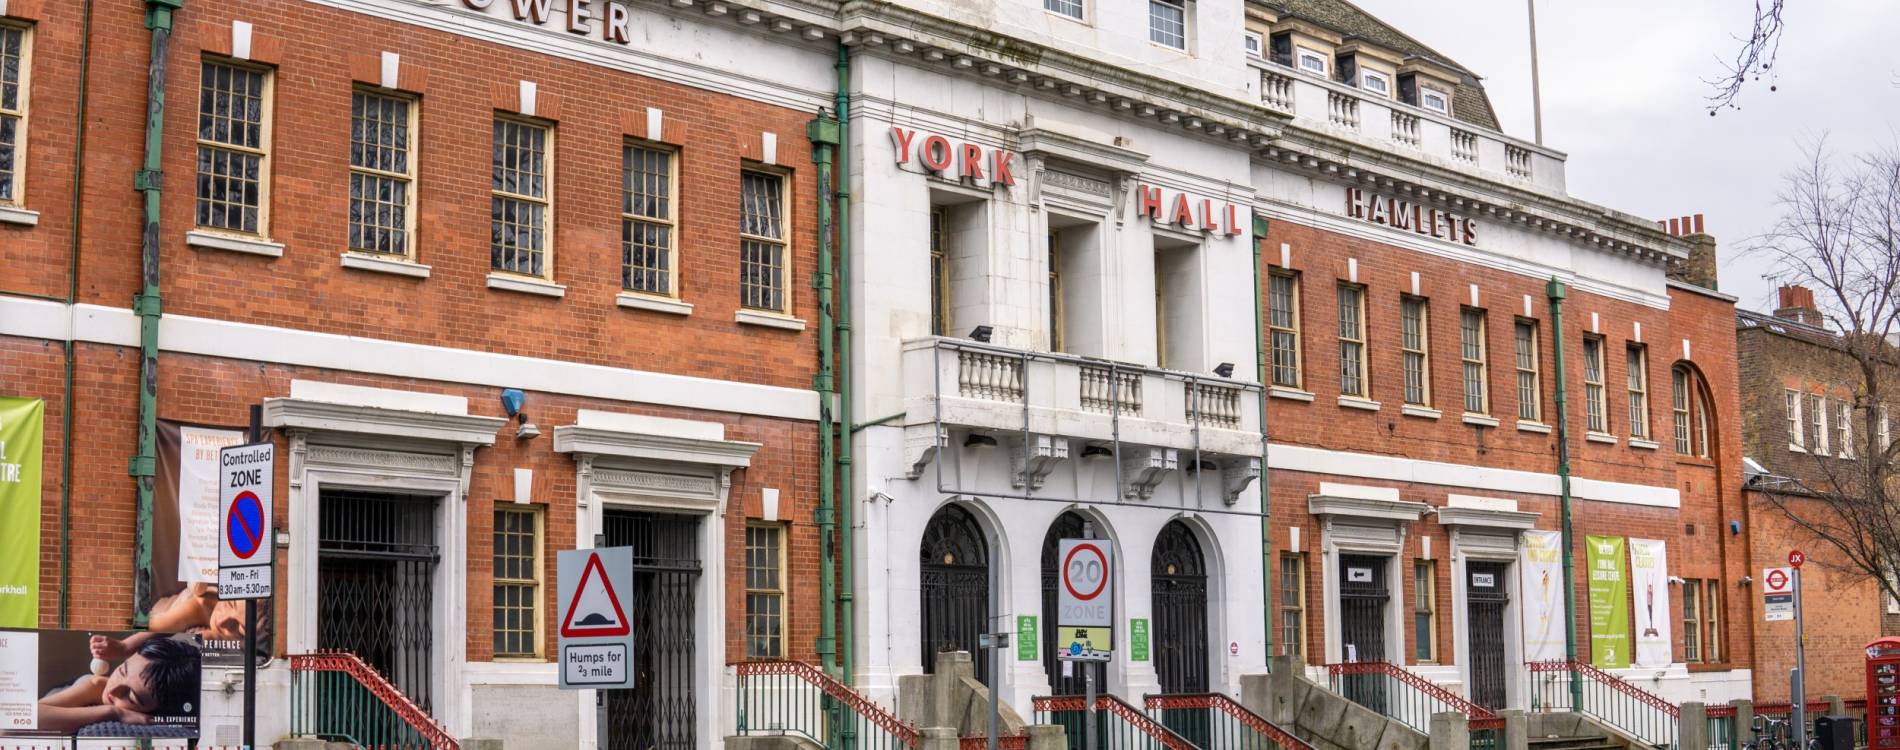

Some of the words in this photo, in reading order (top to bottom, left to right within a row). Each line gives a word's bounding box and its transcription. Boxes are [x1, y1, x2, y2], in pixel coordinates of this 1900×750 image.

[463, 0, 630, 44] WER
[890, 126, 1015, 186] YORK
[1138, 184, 1242, 236] HALL
[1346, 187, 1478, 246] HAMLETS
[223, 448, 271, 466] Controlled
[230, 469, 262, 488] ZONE
[1790, 554, 1802, 564] JX
[231, 570, 245, 581] Mon
[250, 569, 259, 580] Fri
[1070, 560, 1102, 583] 20
[1063, 605, 1106, 619] ZONE
[202, 639, 241, 650] PERIENCE
[569, 652, 605, 665] Humps
[607, 650, 622, 662] for
[591, 665, 613, 677] mile
